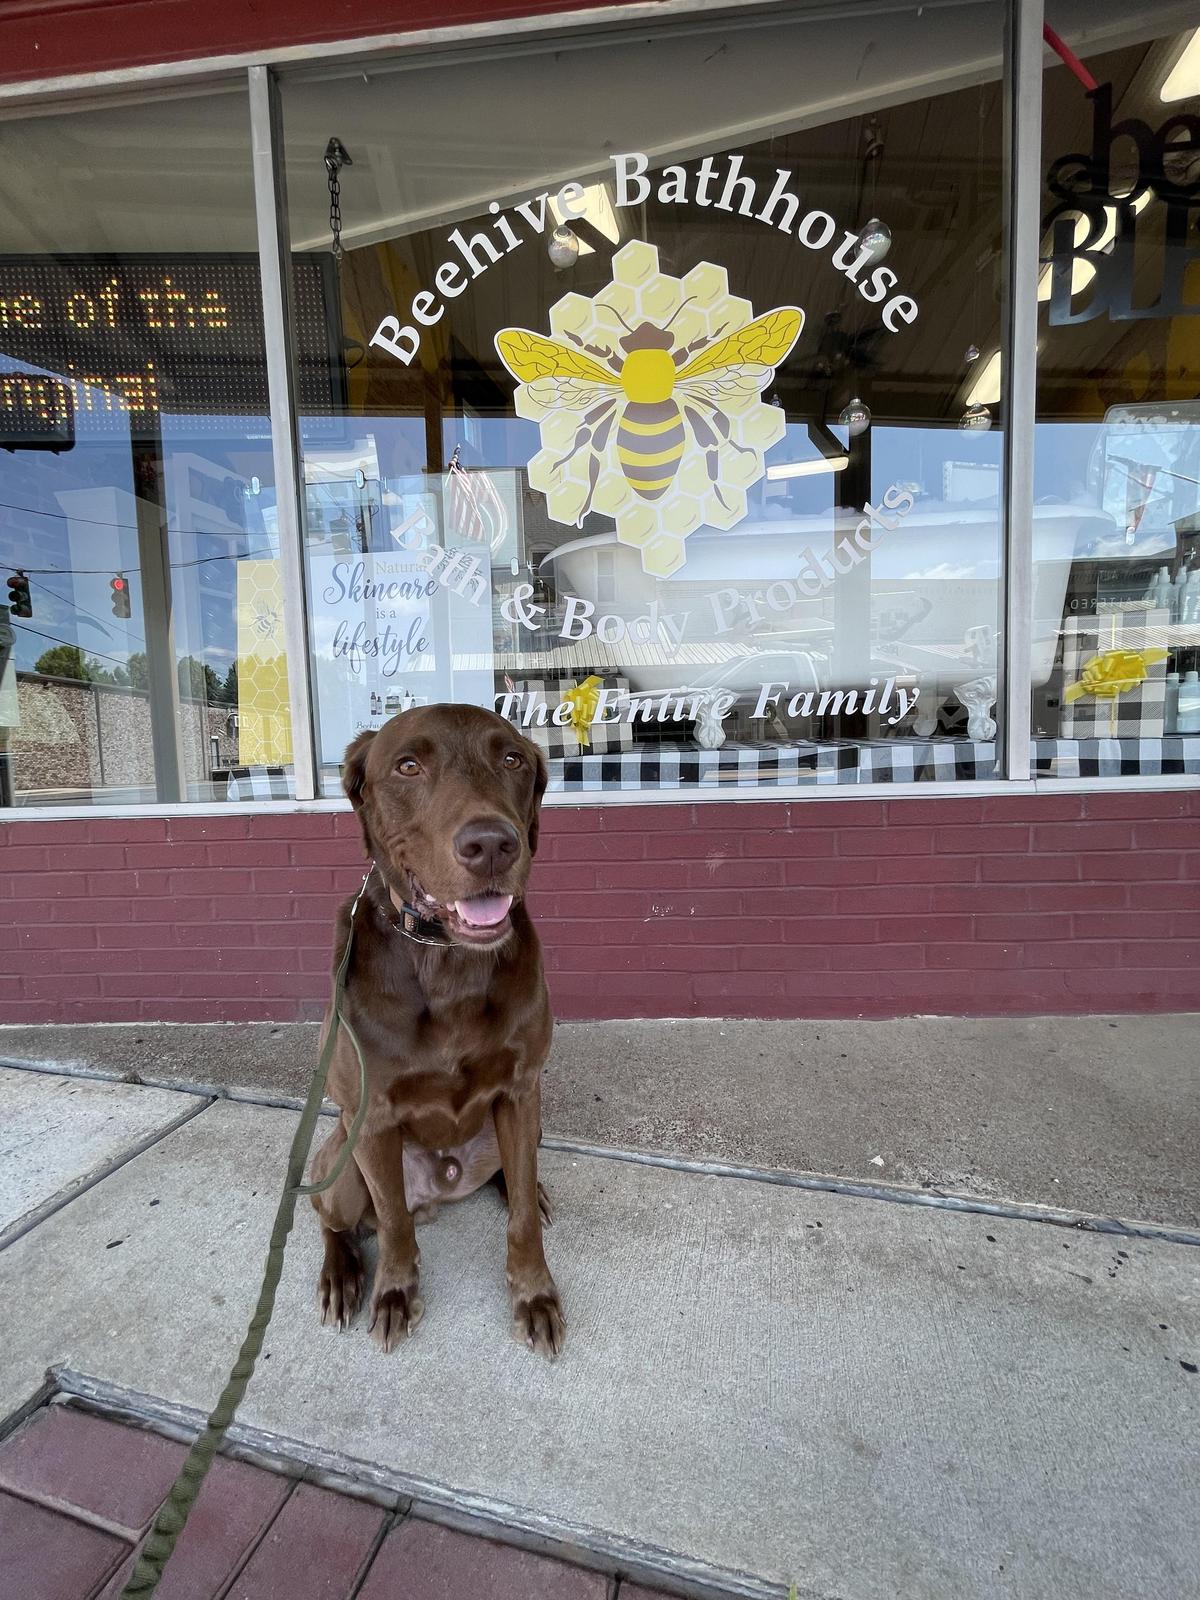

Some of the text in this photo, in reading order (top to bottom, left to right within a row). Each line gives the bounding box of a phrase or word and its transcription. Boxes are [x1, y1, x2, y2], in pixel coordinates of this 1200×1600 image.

[368, 179, 588, 366] Beehive
[609, 151, 919, 334] Bathhouse
[66, 276, 119, 329] of
[322, 561, 440, 605] Skincare
[389, 484, 915, 658] Bath & Body Products
[376, 607, 397, 619] is a
[333, 616, 430, 677] lifestyle
[493, 677, 921, 728] The Entire Family
